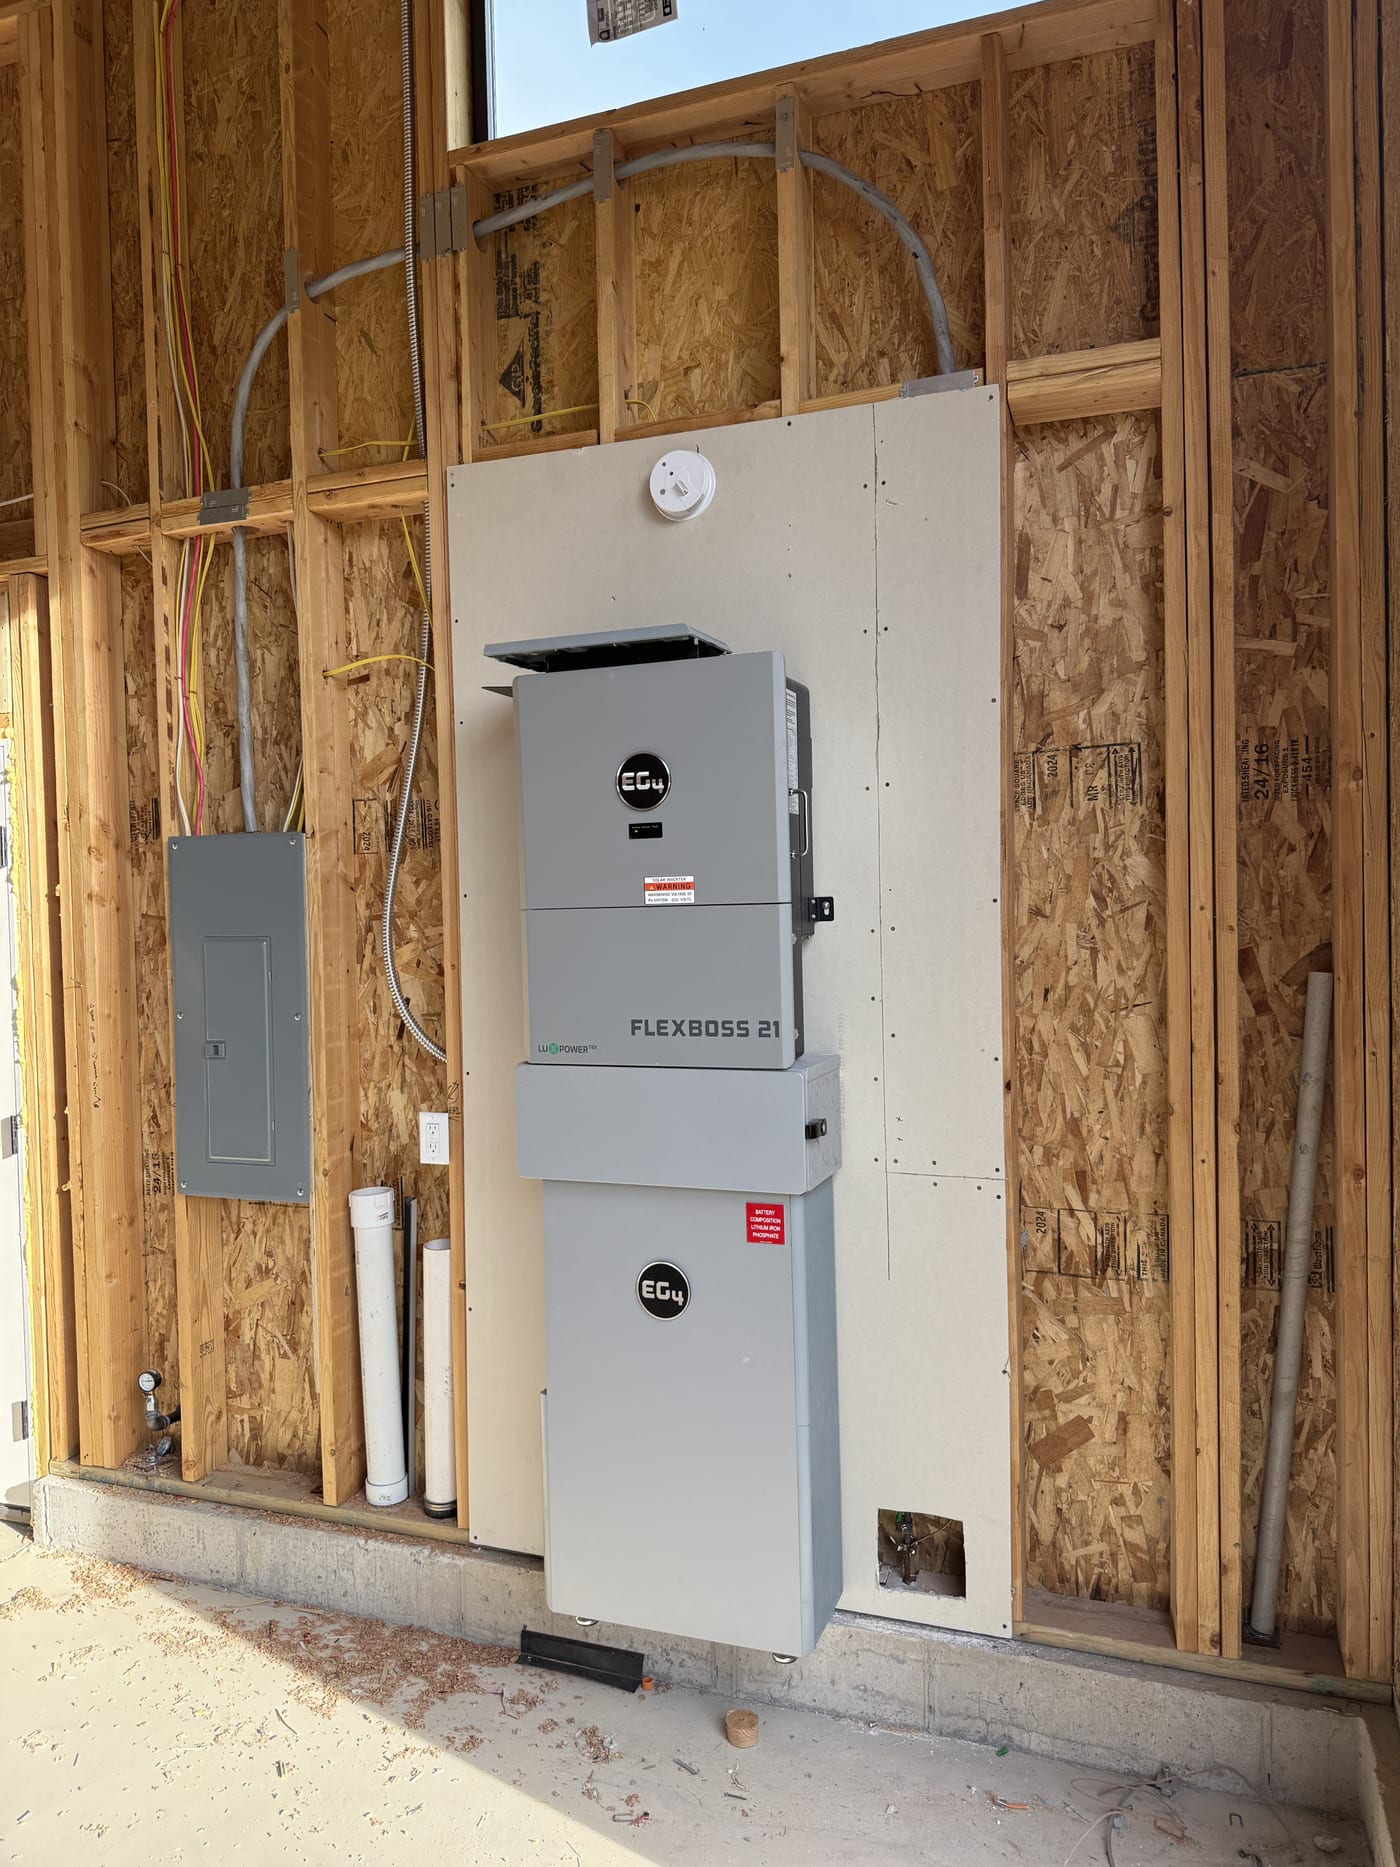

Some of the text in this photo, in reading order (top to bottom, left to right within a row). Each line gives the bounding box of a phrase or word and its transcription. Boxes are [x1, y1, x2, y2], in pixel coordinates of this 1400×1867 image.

[1046, 754, 1058, 778] 2024
[1252, 743, 1271, 801] 24/16
[1301, 756, 1313, 782] 454
[621, 771, 665, 794] EG4
[1087, 785, 1099, 802] MR
[362, 831, 371, 851] 2024
[426, 813, 434, 849] CATEGORY
[656, 882, 691, 891] WARNING
[631, 1019, 781, 1038] FLEXBOSS 21
[1036, 1210, 1047, 1234] 2024
[752, 1231, 780, 1239] PHOSPHATE
[641, 1280, 684, 1306] EG4
